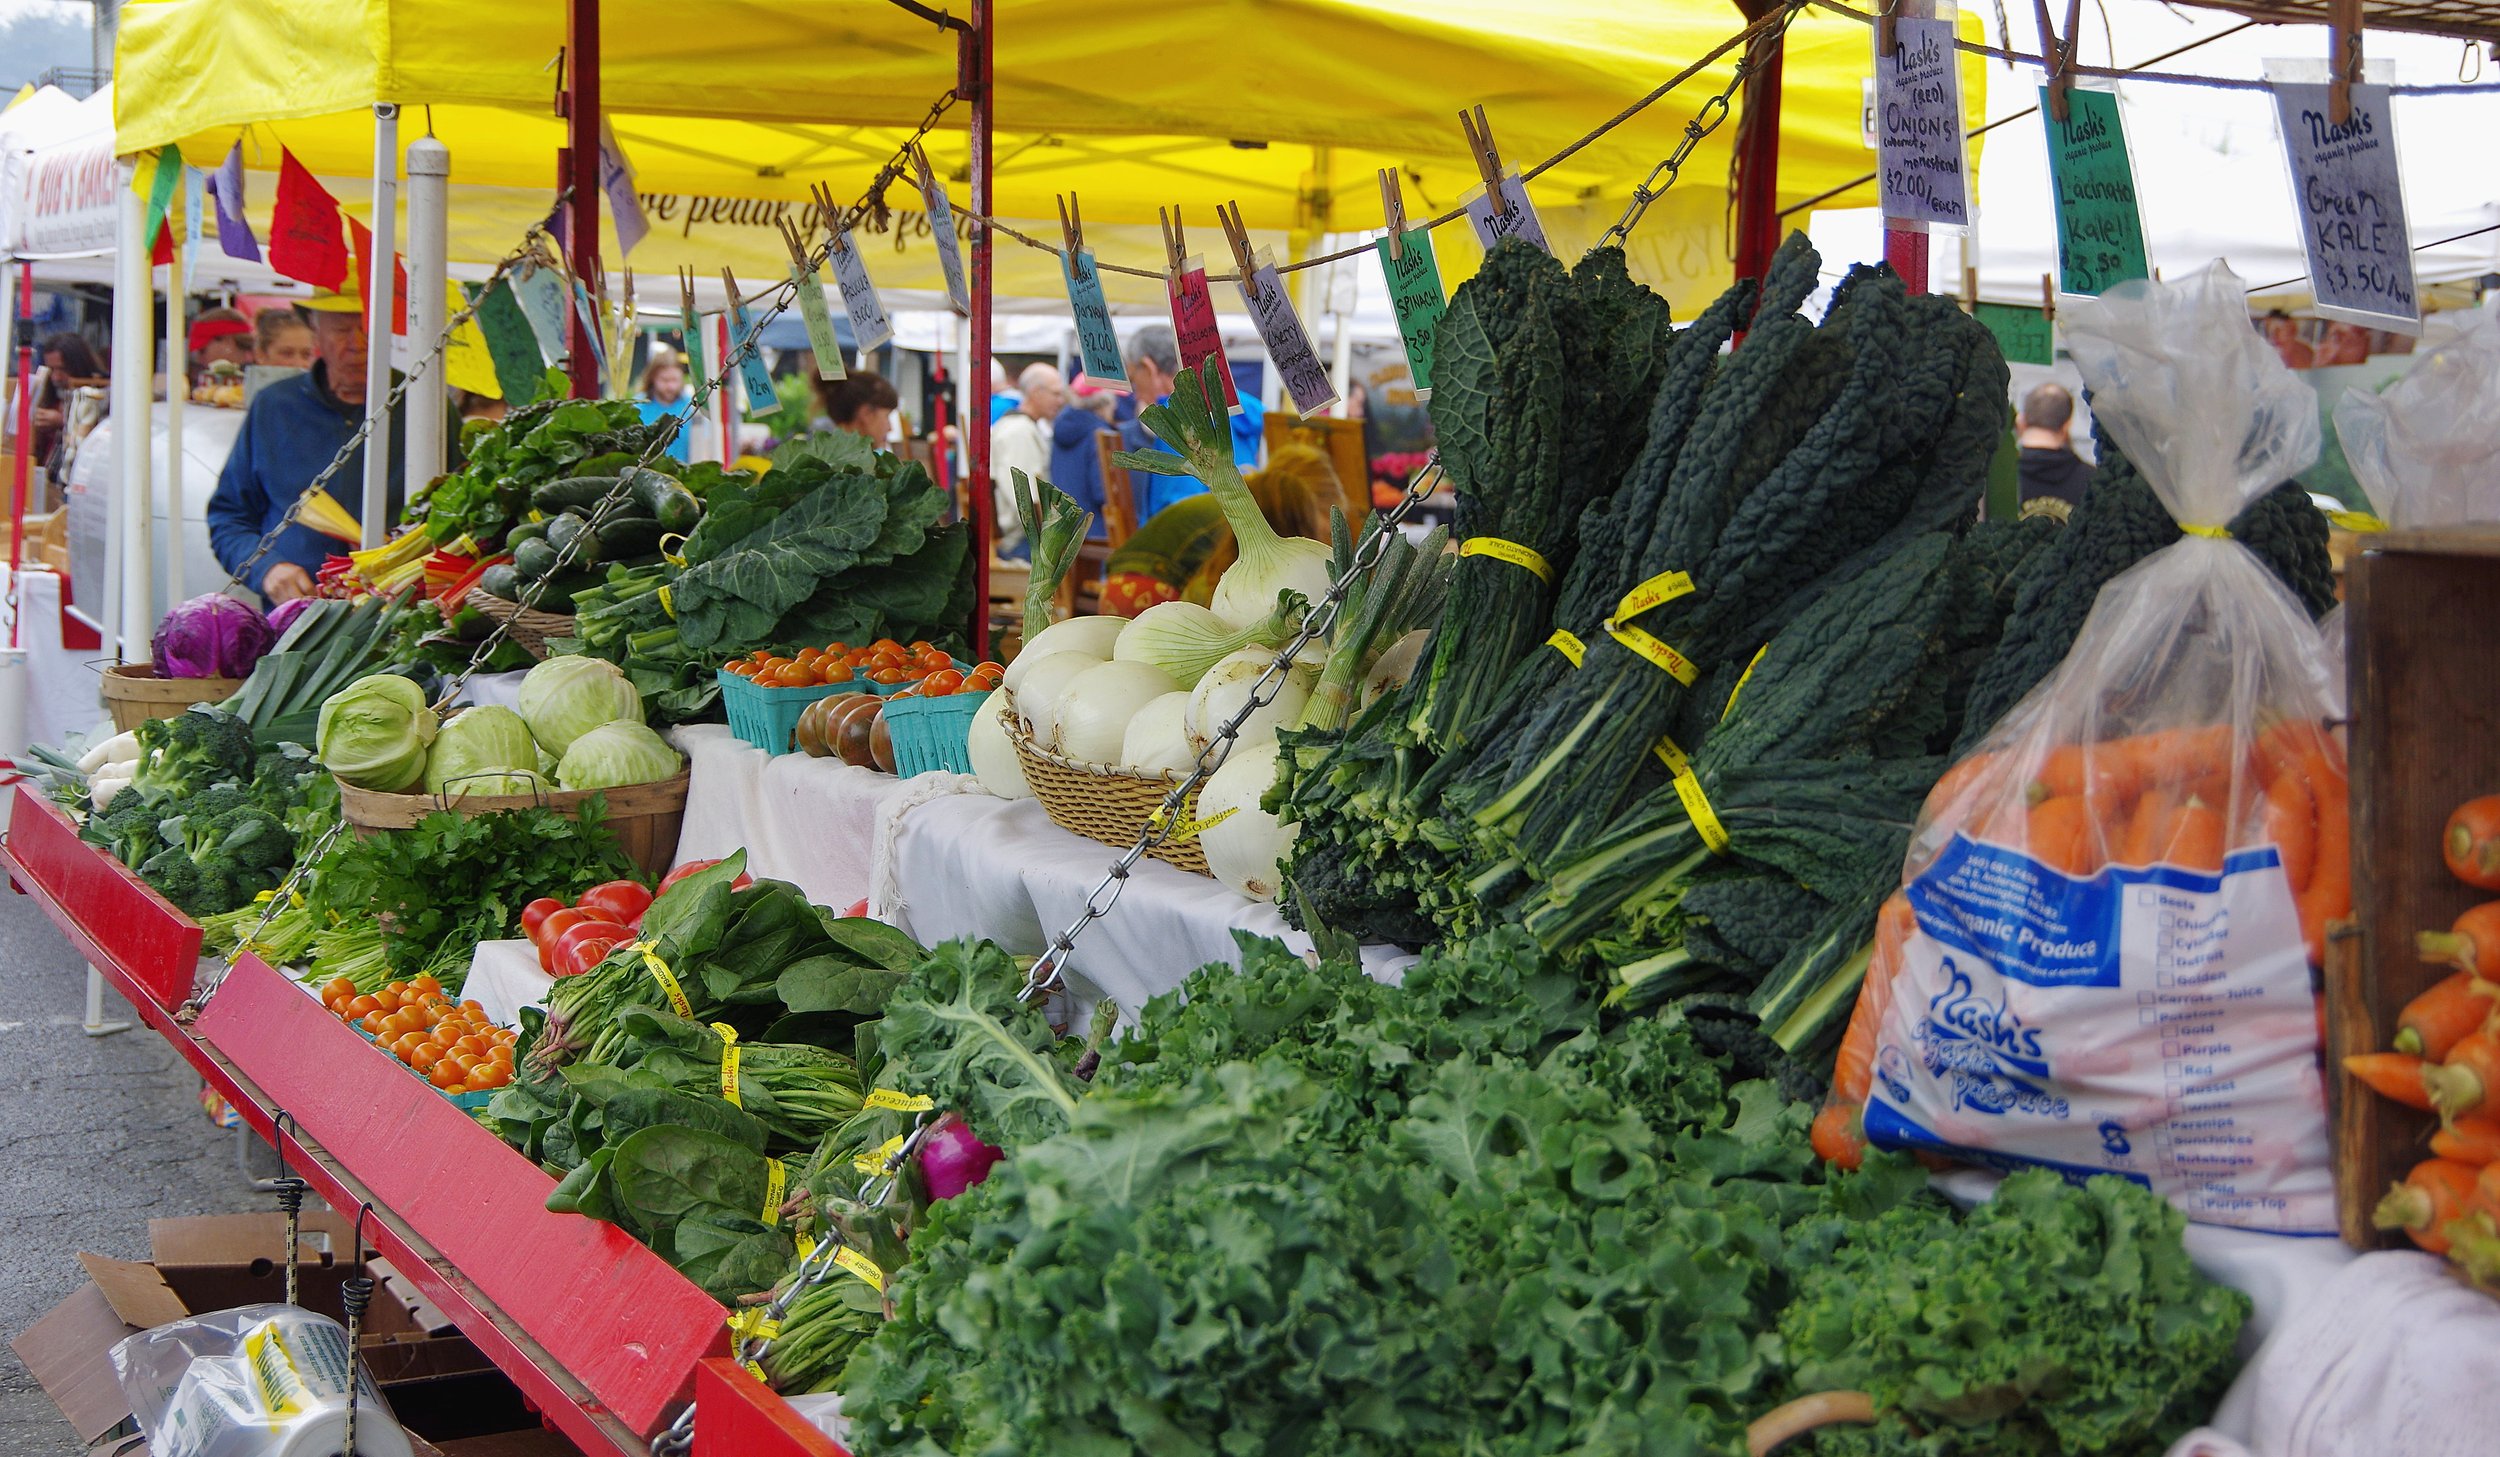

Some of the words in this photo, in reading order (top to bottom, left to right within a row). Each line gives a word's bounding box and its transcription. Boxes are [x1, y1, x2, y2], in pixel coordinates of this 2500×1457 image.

[1896, 30, 1941, 75] Nash's
[2302, 107, 2373, 149] Nash's
[1483, 198, 1520, 240] Nash's
[2316, 219, 2389, 255] KALE
[1396, 286, 1440, 320] SPINACH
[2016, 926, 2098, 960] Produce
[1930, 955, 2043, 1058] Nash's
[2182, 1043, 2232, 1056] Purple
